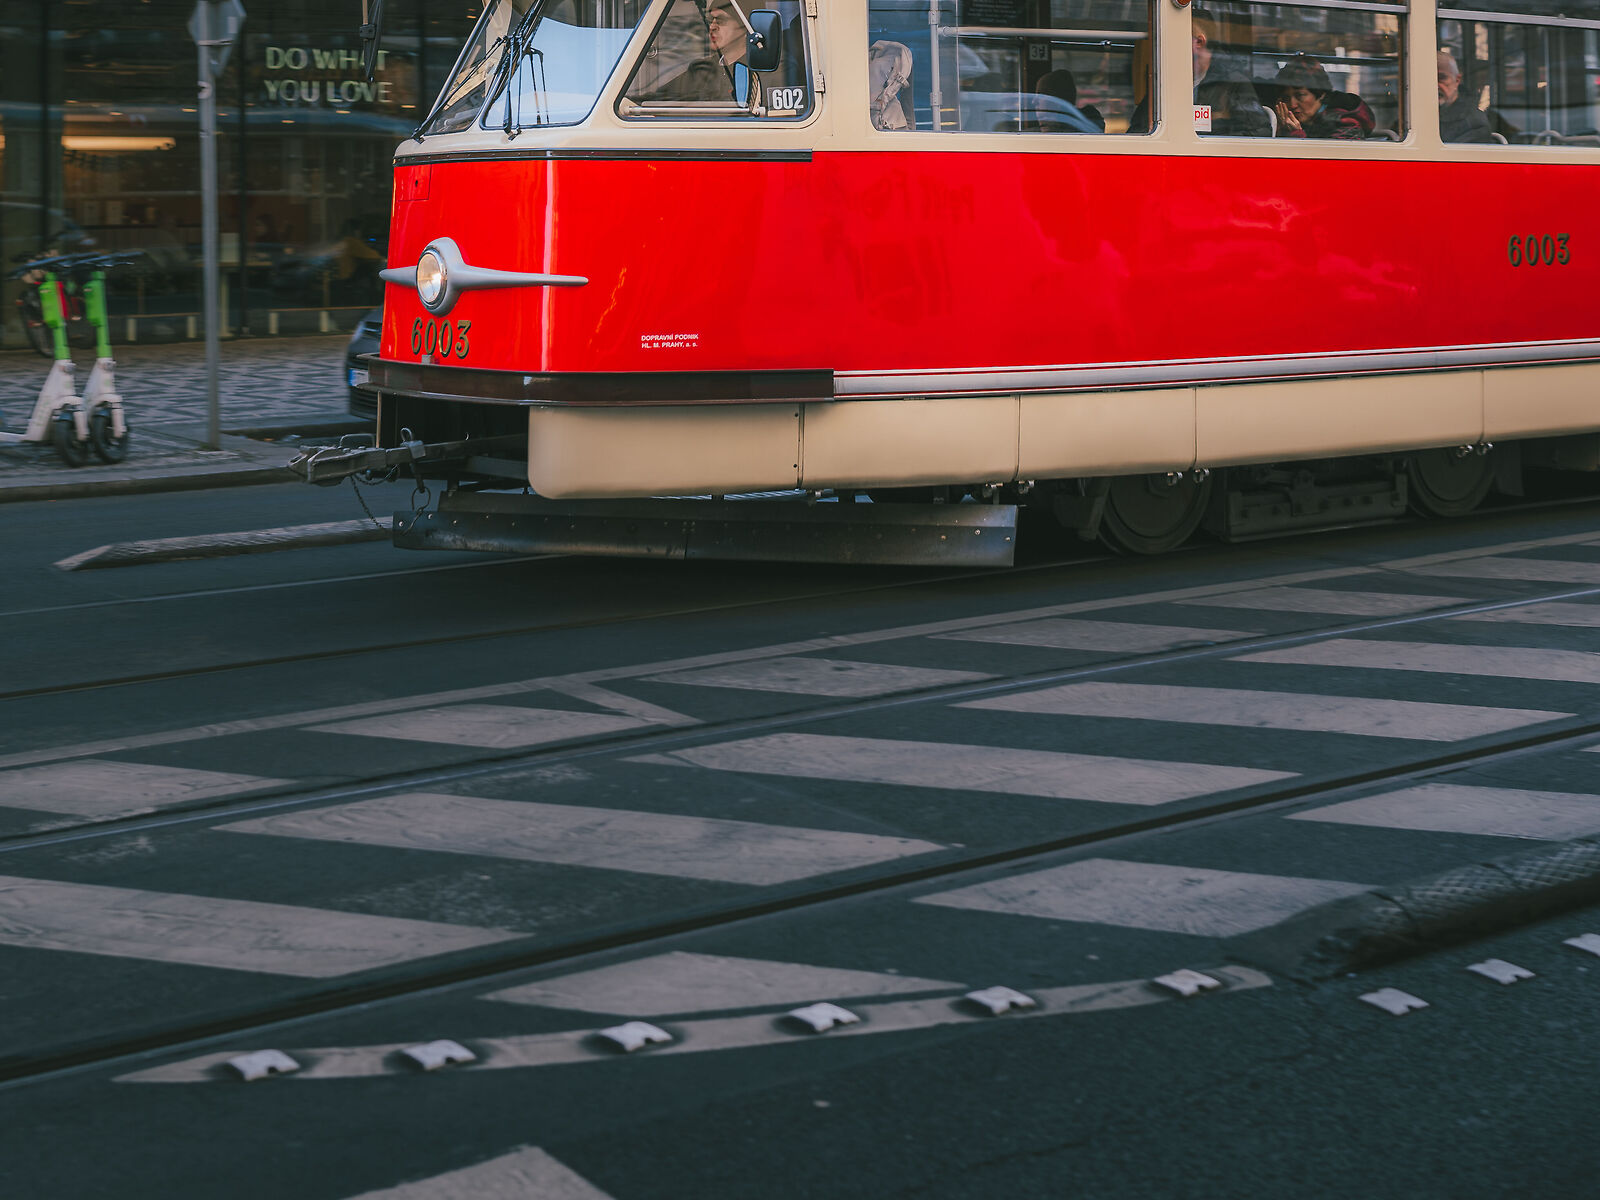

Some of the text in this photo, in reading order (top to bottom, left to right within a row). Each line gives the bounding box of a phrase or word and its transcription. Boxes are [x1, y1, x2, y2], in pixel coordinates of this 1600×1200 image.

[265, 46, 389, 71] DO WHT
[263, 79, 393, 103] YOU LOVE
[772, 88, 804, 110] 602
[1194, 107, 1210, 121] pid
[1507, 233, 1570, 267] 6003
[411, 317, 472, 360] 6003
